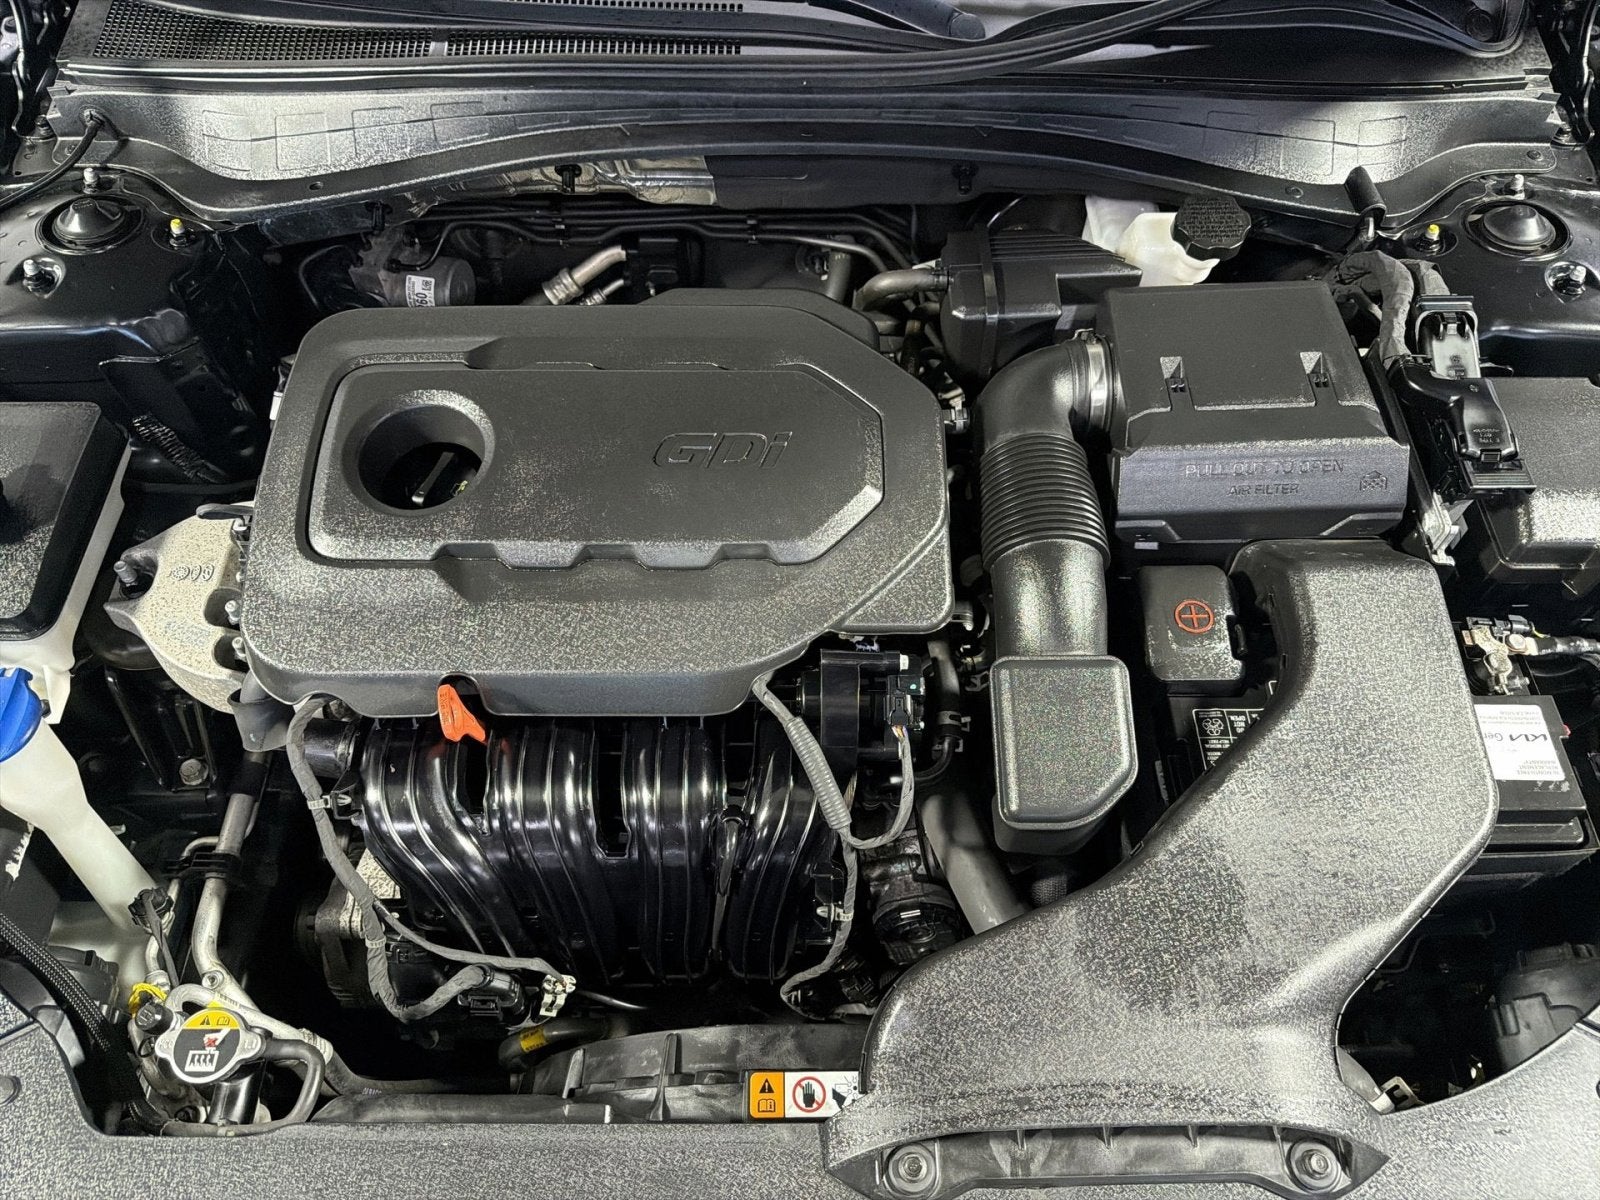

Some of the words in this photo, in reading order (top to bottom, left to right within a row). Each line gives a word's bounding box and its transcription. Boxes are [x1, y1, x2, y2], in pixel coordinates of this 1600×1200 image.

[652, 431, 793, 468] GDi
[1185, 462, 1227, 478] PULL
[1233, 461, 1266, 476] OUT
[1271, 460, 1294, 475] TO
[1299, 459, 1344, 474] OPEN
[1229, 484, 1251, 496] AIR
[1254, 483, 1300, 495] FILTER
